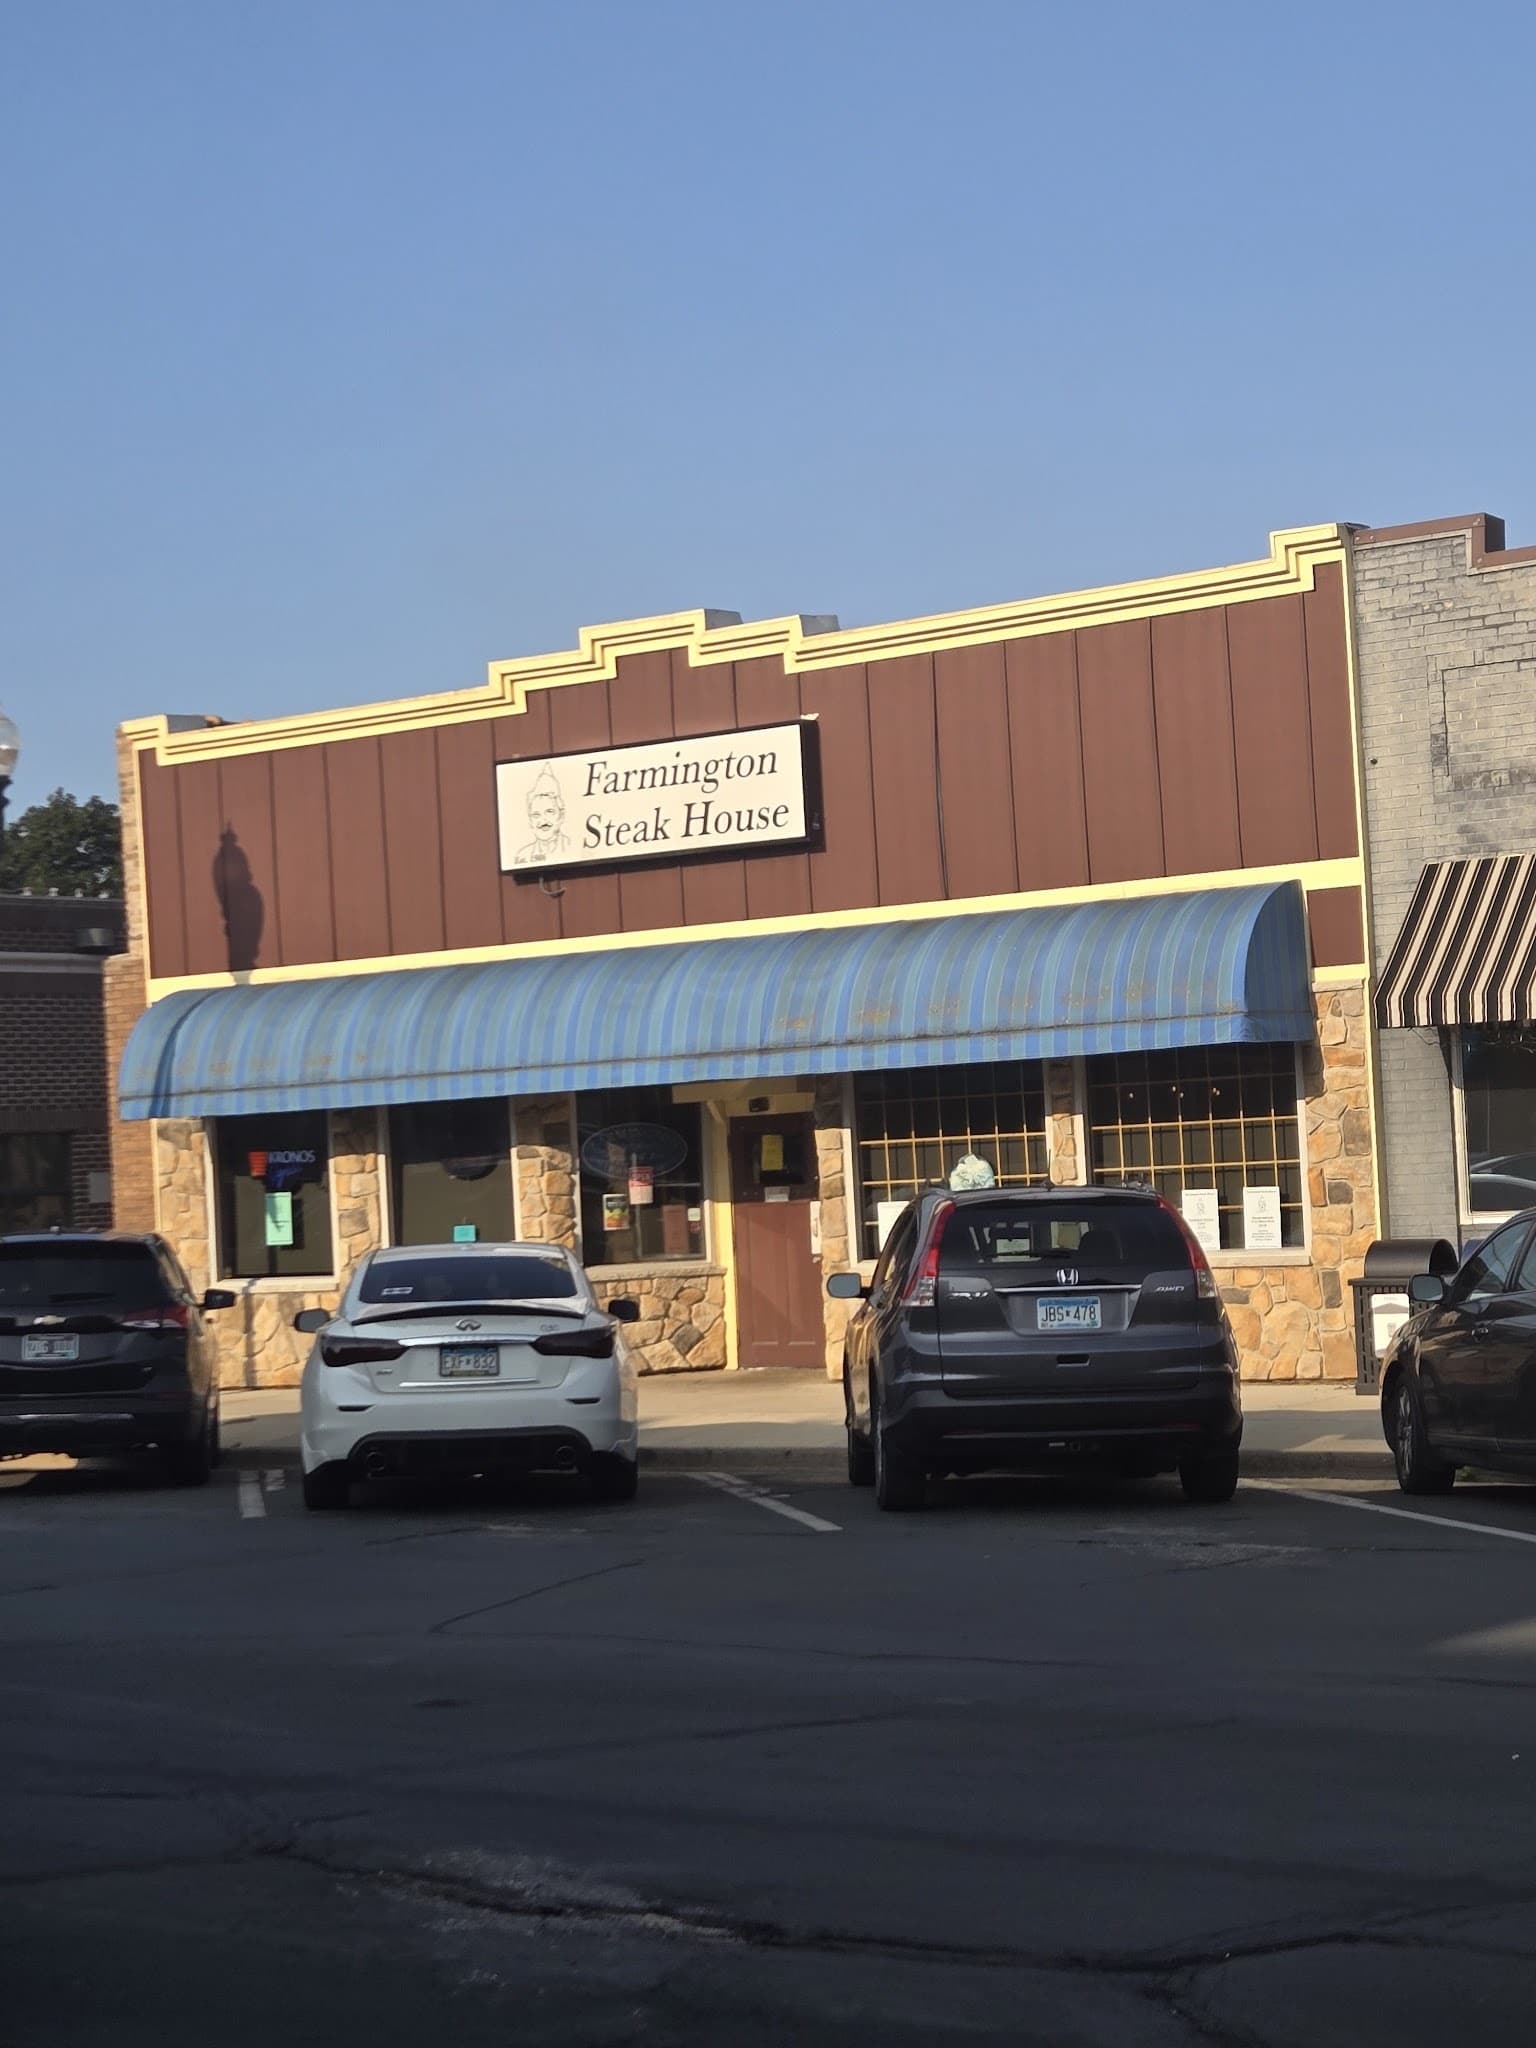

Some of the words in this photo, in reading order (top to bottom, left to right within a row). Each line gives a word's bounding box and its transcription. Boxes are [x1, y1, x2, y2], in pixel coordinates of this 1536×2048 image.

[583, 751, 778, 796] Farmington
[583, 808, 671, 848] Steak
[681, 801, 789, 838] House
[269, 1150, 316, 1163] KRONOS
